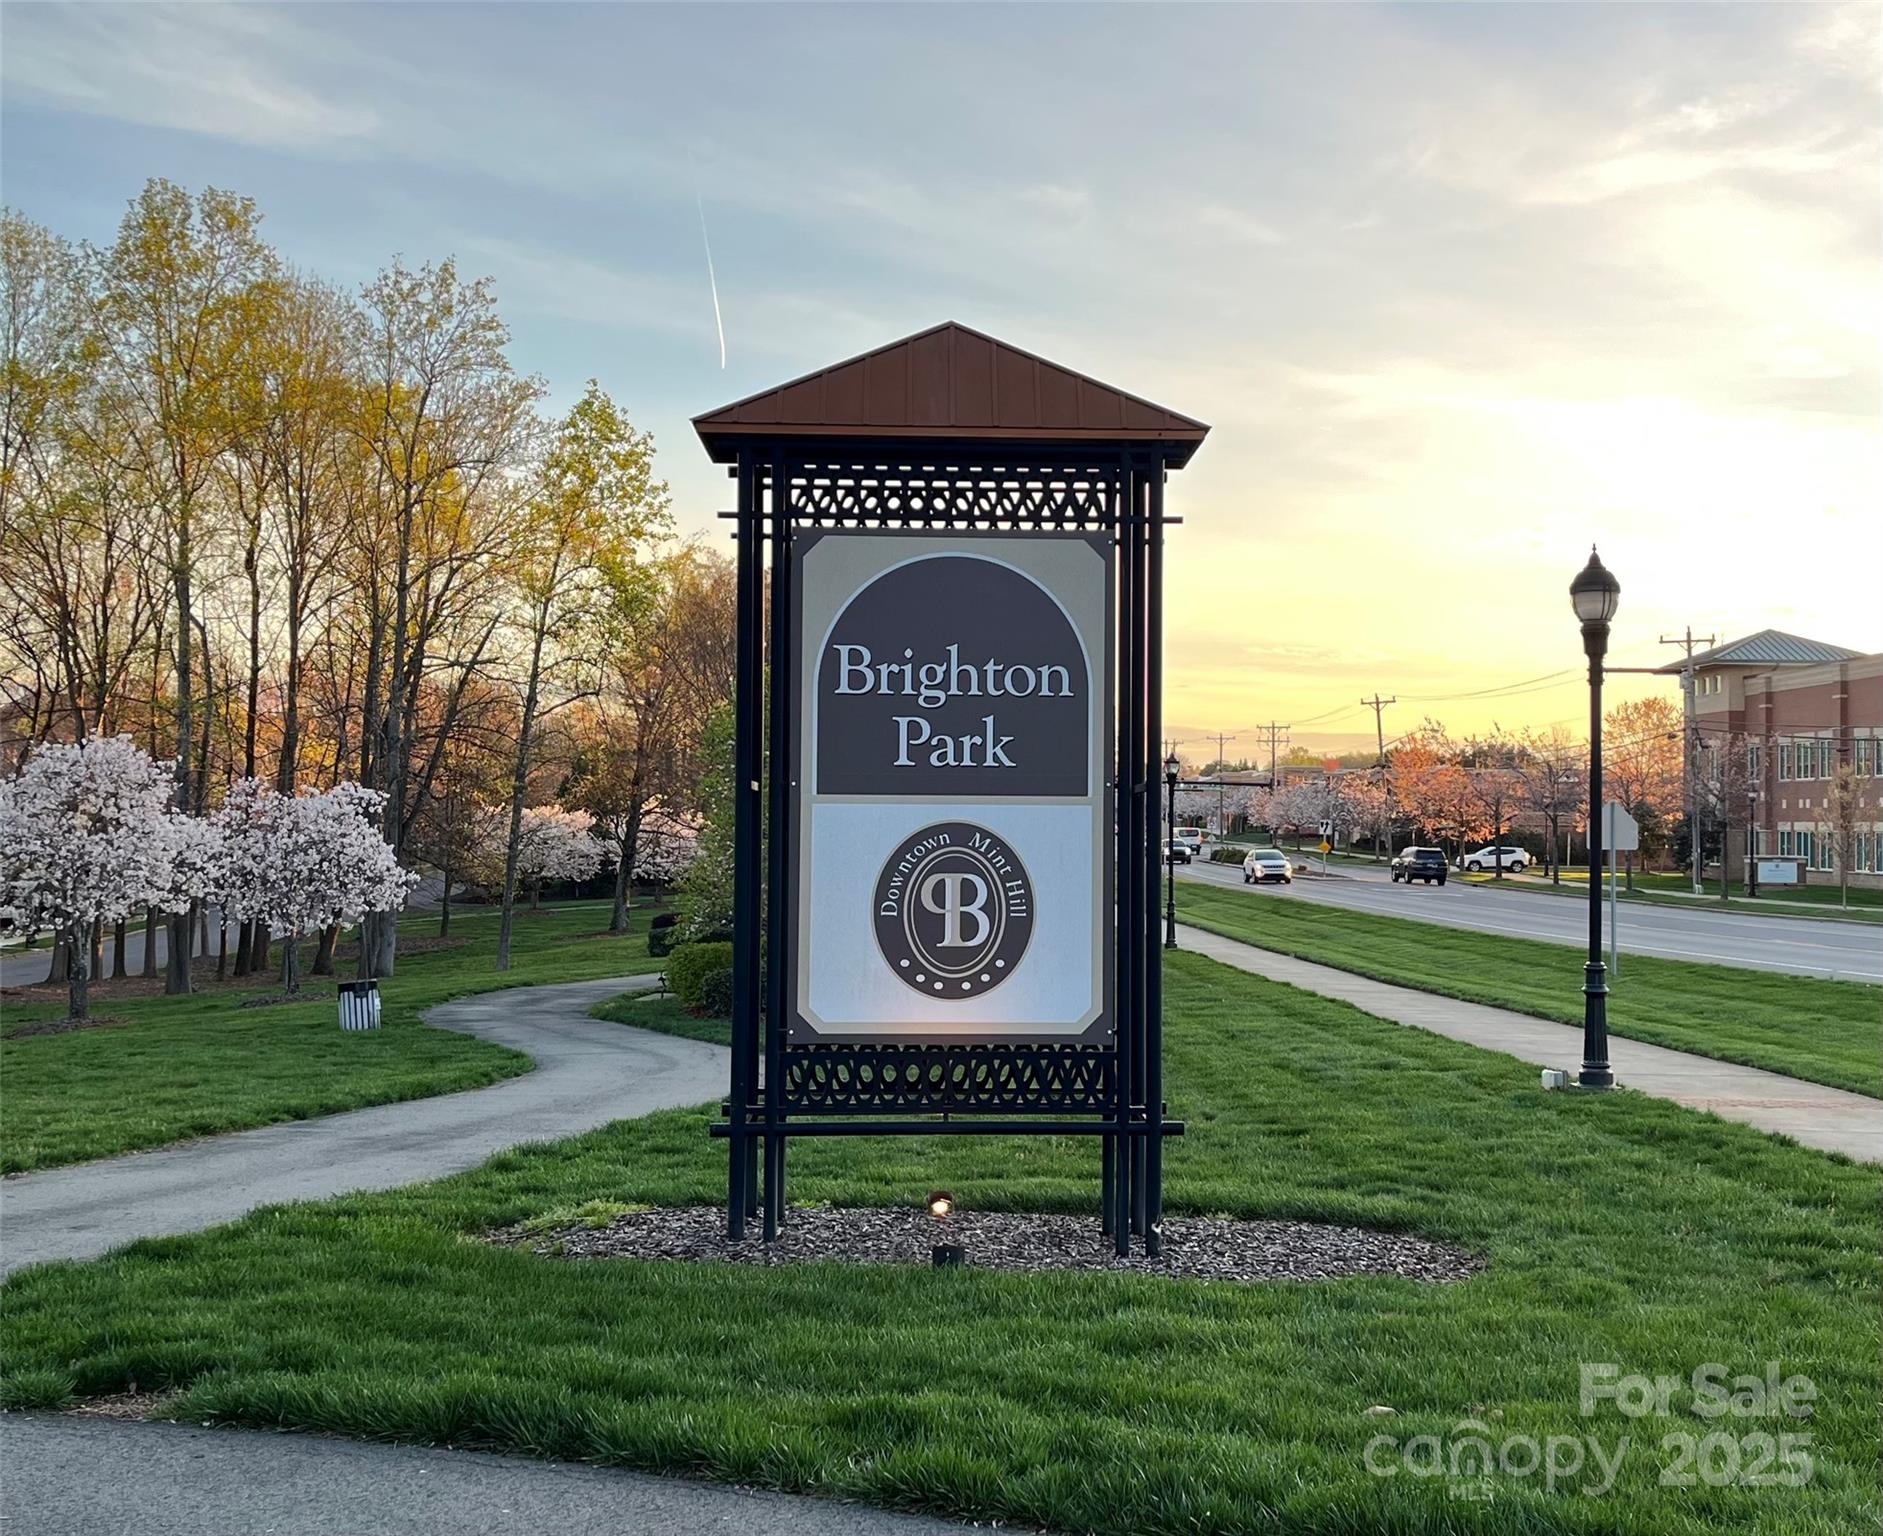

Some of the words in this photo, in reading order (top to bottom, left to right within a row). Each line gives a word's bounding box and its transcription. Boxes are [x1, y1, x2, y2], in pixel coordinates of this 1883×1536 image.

[833, 643, 1075, 709] Brighton
[892, 714, 1018, 768] Park
[880, 832, 952, 918] Downtown
[968, 831, 1013, 876] Mint
[1005, 879, 1028, 918] Hill
